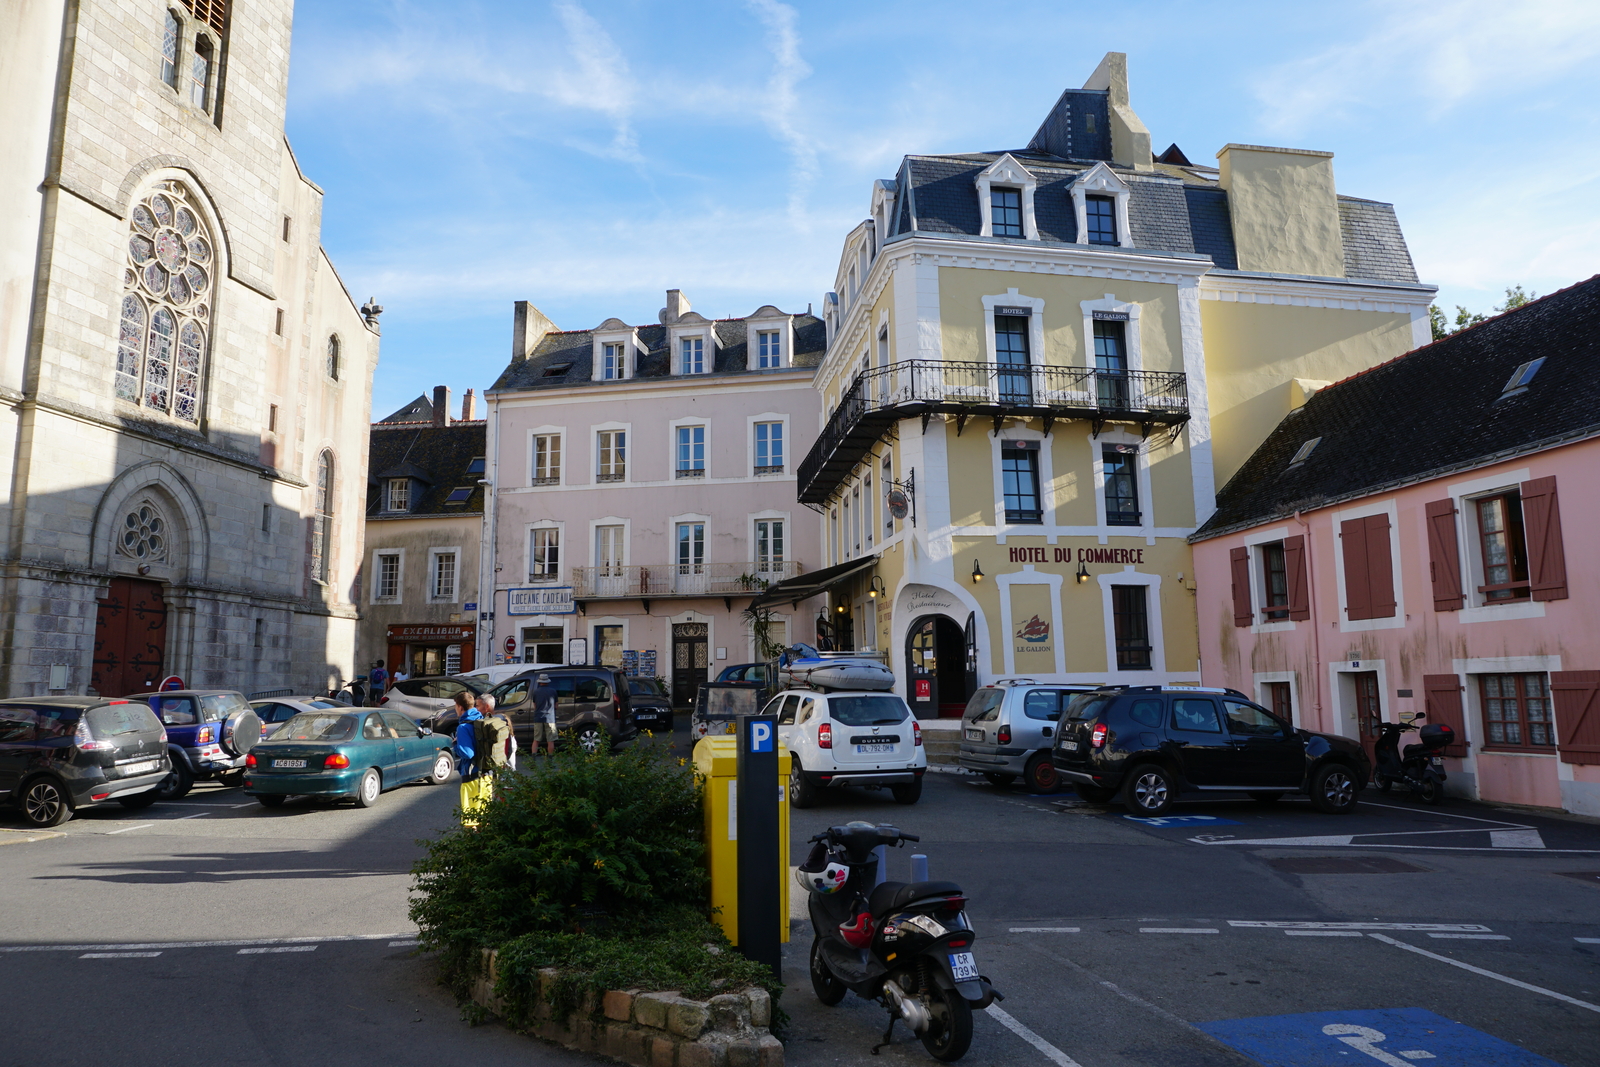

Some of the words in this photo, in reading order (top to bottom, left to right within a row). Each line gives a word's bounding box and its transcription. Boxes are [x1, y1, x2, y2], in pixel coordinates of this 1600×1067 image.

[1009, 547, 1049, 563] HOTEL
[1054, 547, 1072, 563] DU
[1077, 547, 1144, 564] COMMERCE
[907, 601, 952, 614] Restaurant
[402, 627, 462, 635] EXCALIBUR
[752, 723, 771, 751] P
[957, 954, 969, 965] CR
[952, 965, 970, 978] 739
[970, 964, 978, 975] N
